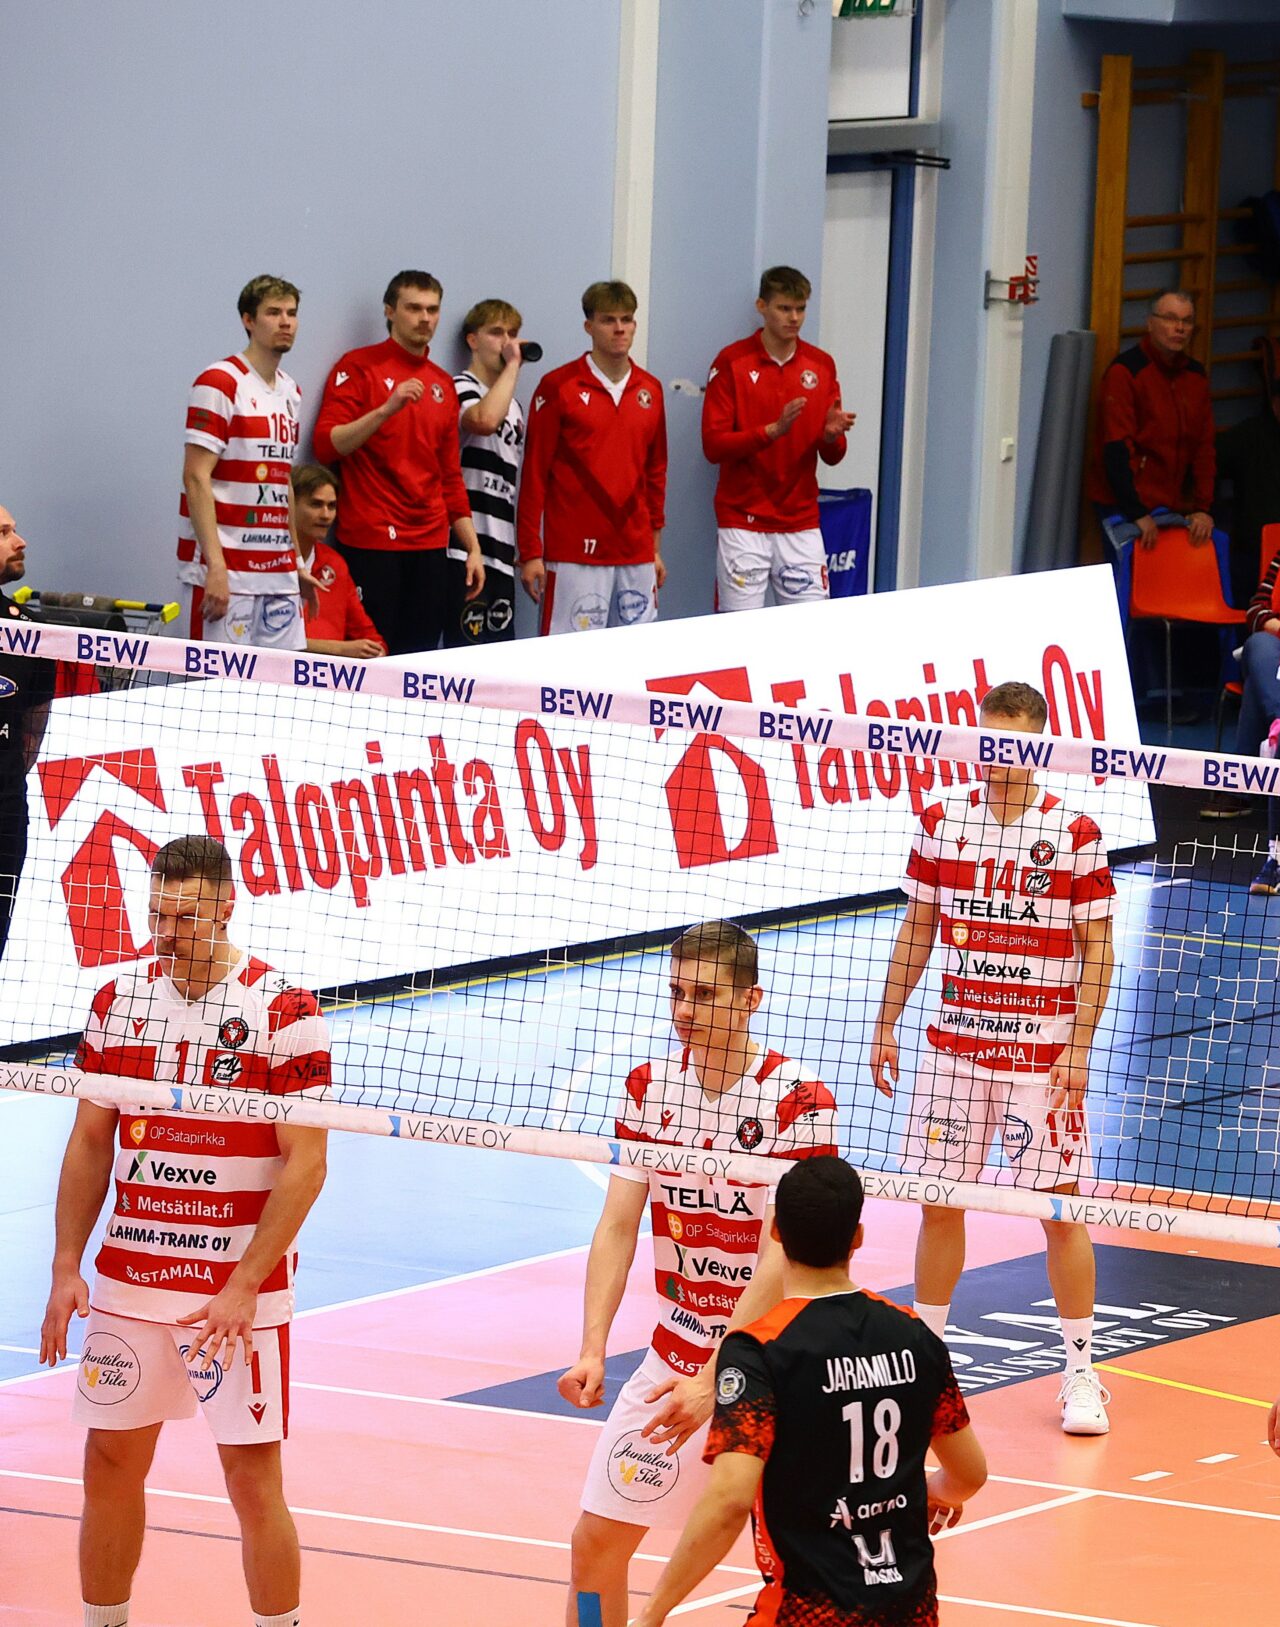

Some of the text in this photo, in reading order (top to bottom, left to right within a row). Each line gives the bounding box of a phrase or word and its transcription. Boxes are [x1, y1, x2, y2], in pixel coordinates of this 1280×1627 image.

[388, 525, 397, 540] 8
[584, 539, 597, 554] 17
[0, 625, 41, 655] WI
[77, 633, 150, 667] BEWI
[185, 646, 258, 680] BEWI
[294, 659, 367, 692] BEWI
[403, 671, 476, 704] BEWI
[541, 686, 614, 719] BEWI
[650, 699, 723, 731] BEWI
[760, 711, 833, 745] BEWI
[868, 723, 942, 757] BEWI
[980, 736, 1053, 768] BEWI
[1091, 747, 1167, 780] BEWI
[1203, 758, 1280, 793] BEWI
[181, 719, 599, 908] Talopinta Oy
[981, 857, 1015, 899] 14
[971, 929, 986, 943] OP
[973, 959, 1032, 980] Vexve
[51, 1075, 81, 1096] OY
[189, 1091, 293, 1122] VEXVE OY
[150, 1126, 226, 1147] OP Satapirkka
[407, 1119, 512, 1149] VEXVE OY
[150, 1160, 217, 1185] Vexve
[627, 1147, 733, 1178] VEXVE OY
[924, 1184, 955, 1205] OY
[137, 1195, 234, 1219] Metsätilat.fi
[1069, 1202, 1178, 1233] VEXVE OY
[109, 1224, 232, 1252] LAHMA-TRANS OY
[685, 1223, 703, 1238] OP
[125, 1264, 214, 1285] SASTAMALA
[692, 1256, 753, 1283] Vexve
[1152, 1309, 1239, 1330] OY
[81, 1346, 134, 1370] Junttilan
[98, 1369, 128, 1388] Tila
[822, 1349, 916, 1394] JARAMILLO
[842, 1398, 901, 1483] 18
[614, 1441, 673, 1472] Junttilan
[634, 1466, 664, 1488] Tila
